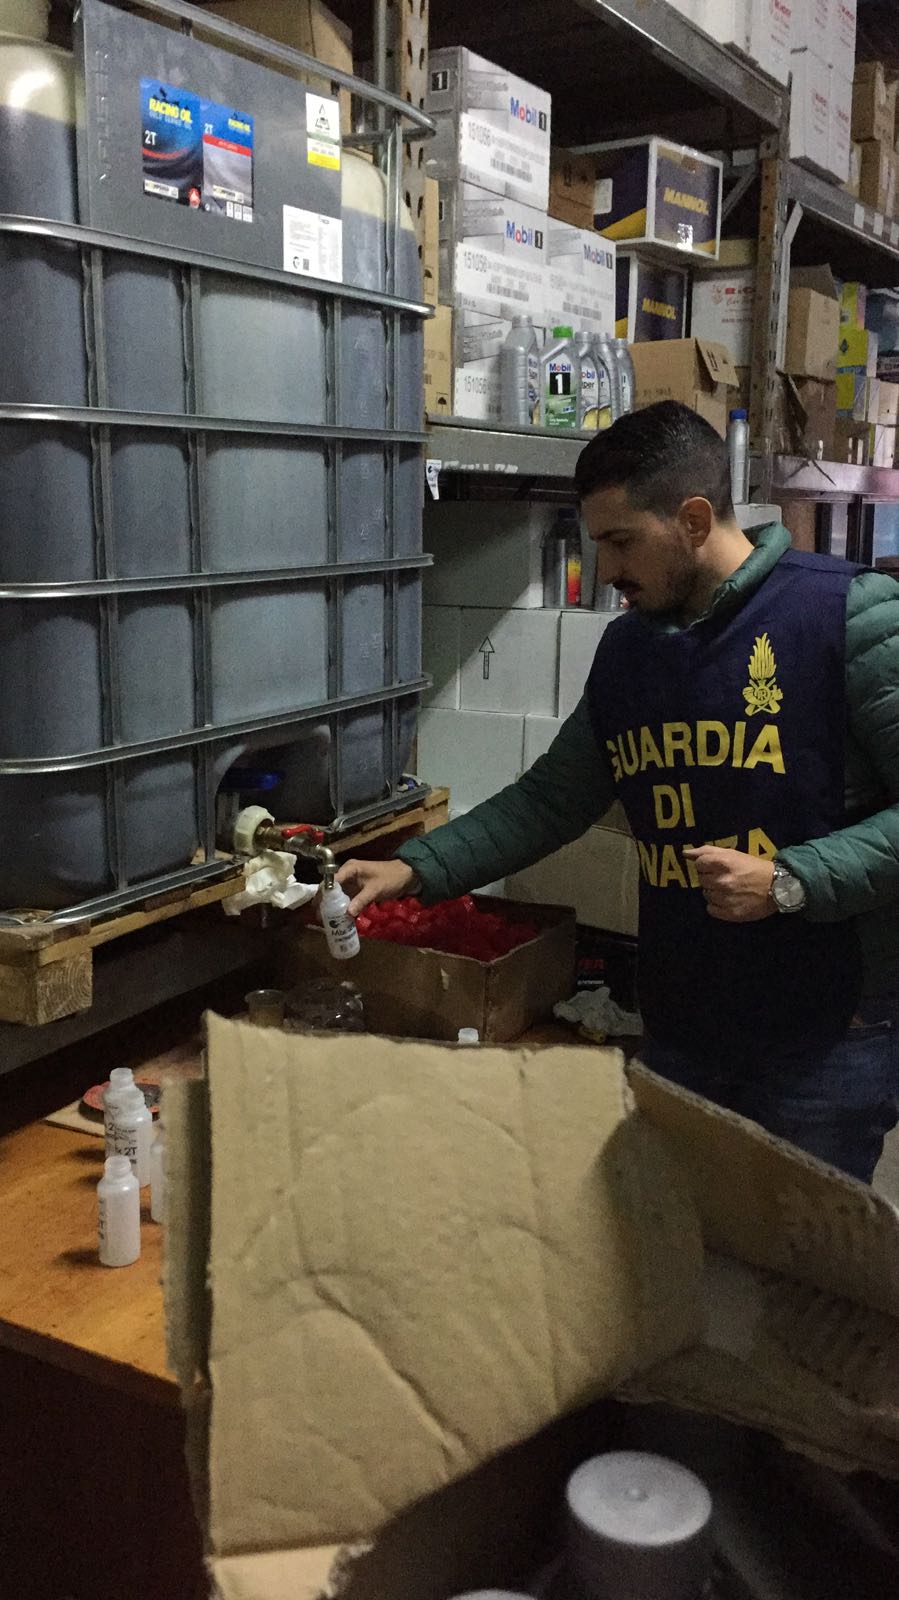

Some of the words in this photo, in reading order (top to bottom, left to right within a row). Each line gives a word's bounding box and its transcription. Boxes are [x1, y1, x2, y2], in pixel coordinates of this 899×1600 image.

[149, 97, 180, 119] RACING
[510, 96, 537, 126] Mobil
[145, 129, 156, 146] 2T
[204, 122, 213, 135] 2T
[663, 186, 710, 216] MANNOL
[506, 219, 533, 246] Mobil
[583, 243, 605, 266] Mobil
[549, 363, 571, 372] Mobil
[652, 782, 696, 829] DI
[124, 1147, 138, 1156] 2T
